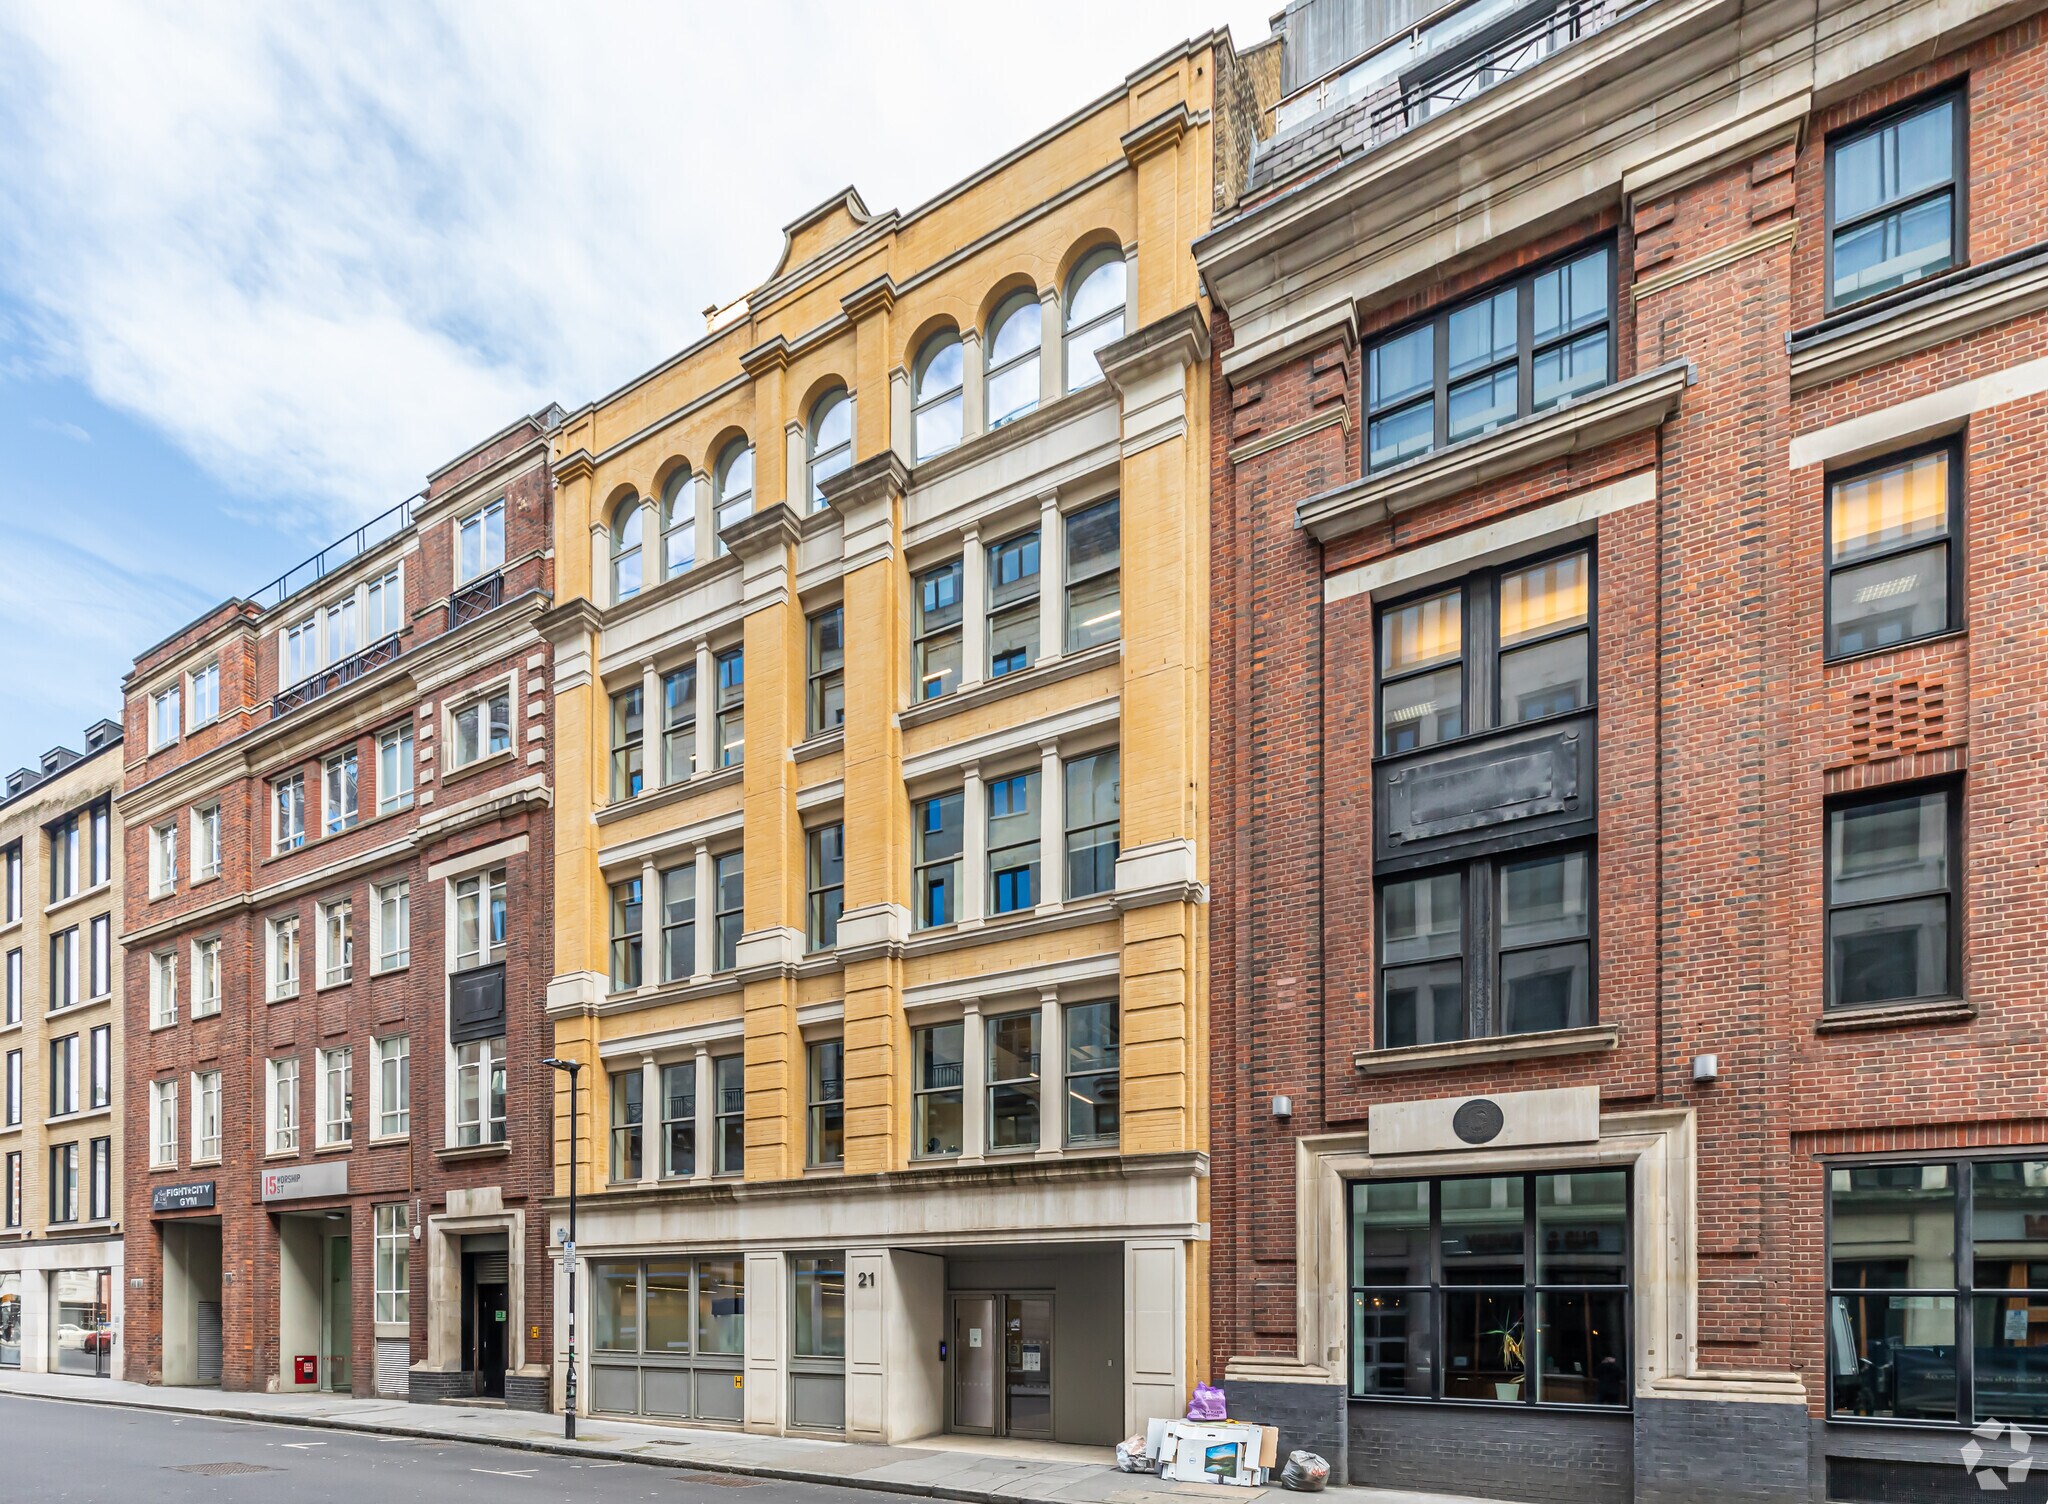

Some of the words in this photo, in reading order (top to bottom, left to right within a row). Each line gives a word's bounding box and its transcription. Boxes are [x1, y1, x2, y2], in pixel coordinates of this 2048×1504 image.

[277, 1173, 301, 1184] WORSHIP
[166, 1186, 188, 1197] FIGHT
[191, 1185, 210, 1195] CITY
[265, 1176, 276, 1195] 15
[277, 1185, 284, 1194] ST
[179, 1197, 198, 1207] GYM
[858, 1272, 875, 1288] 21
[735, 1376, 742, 1387] H
